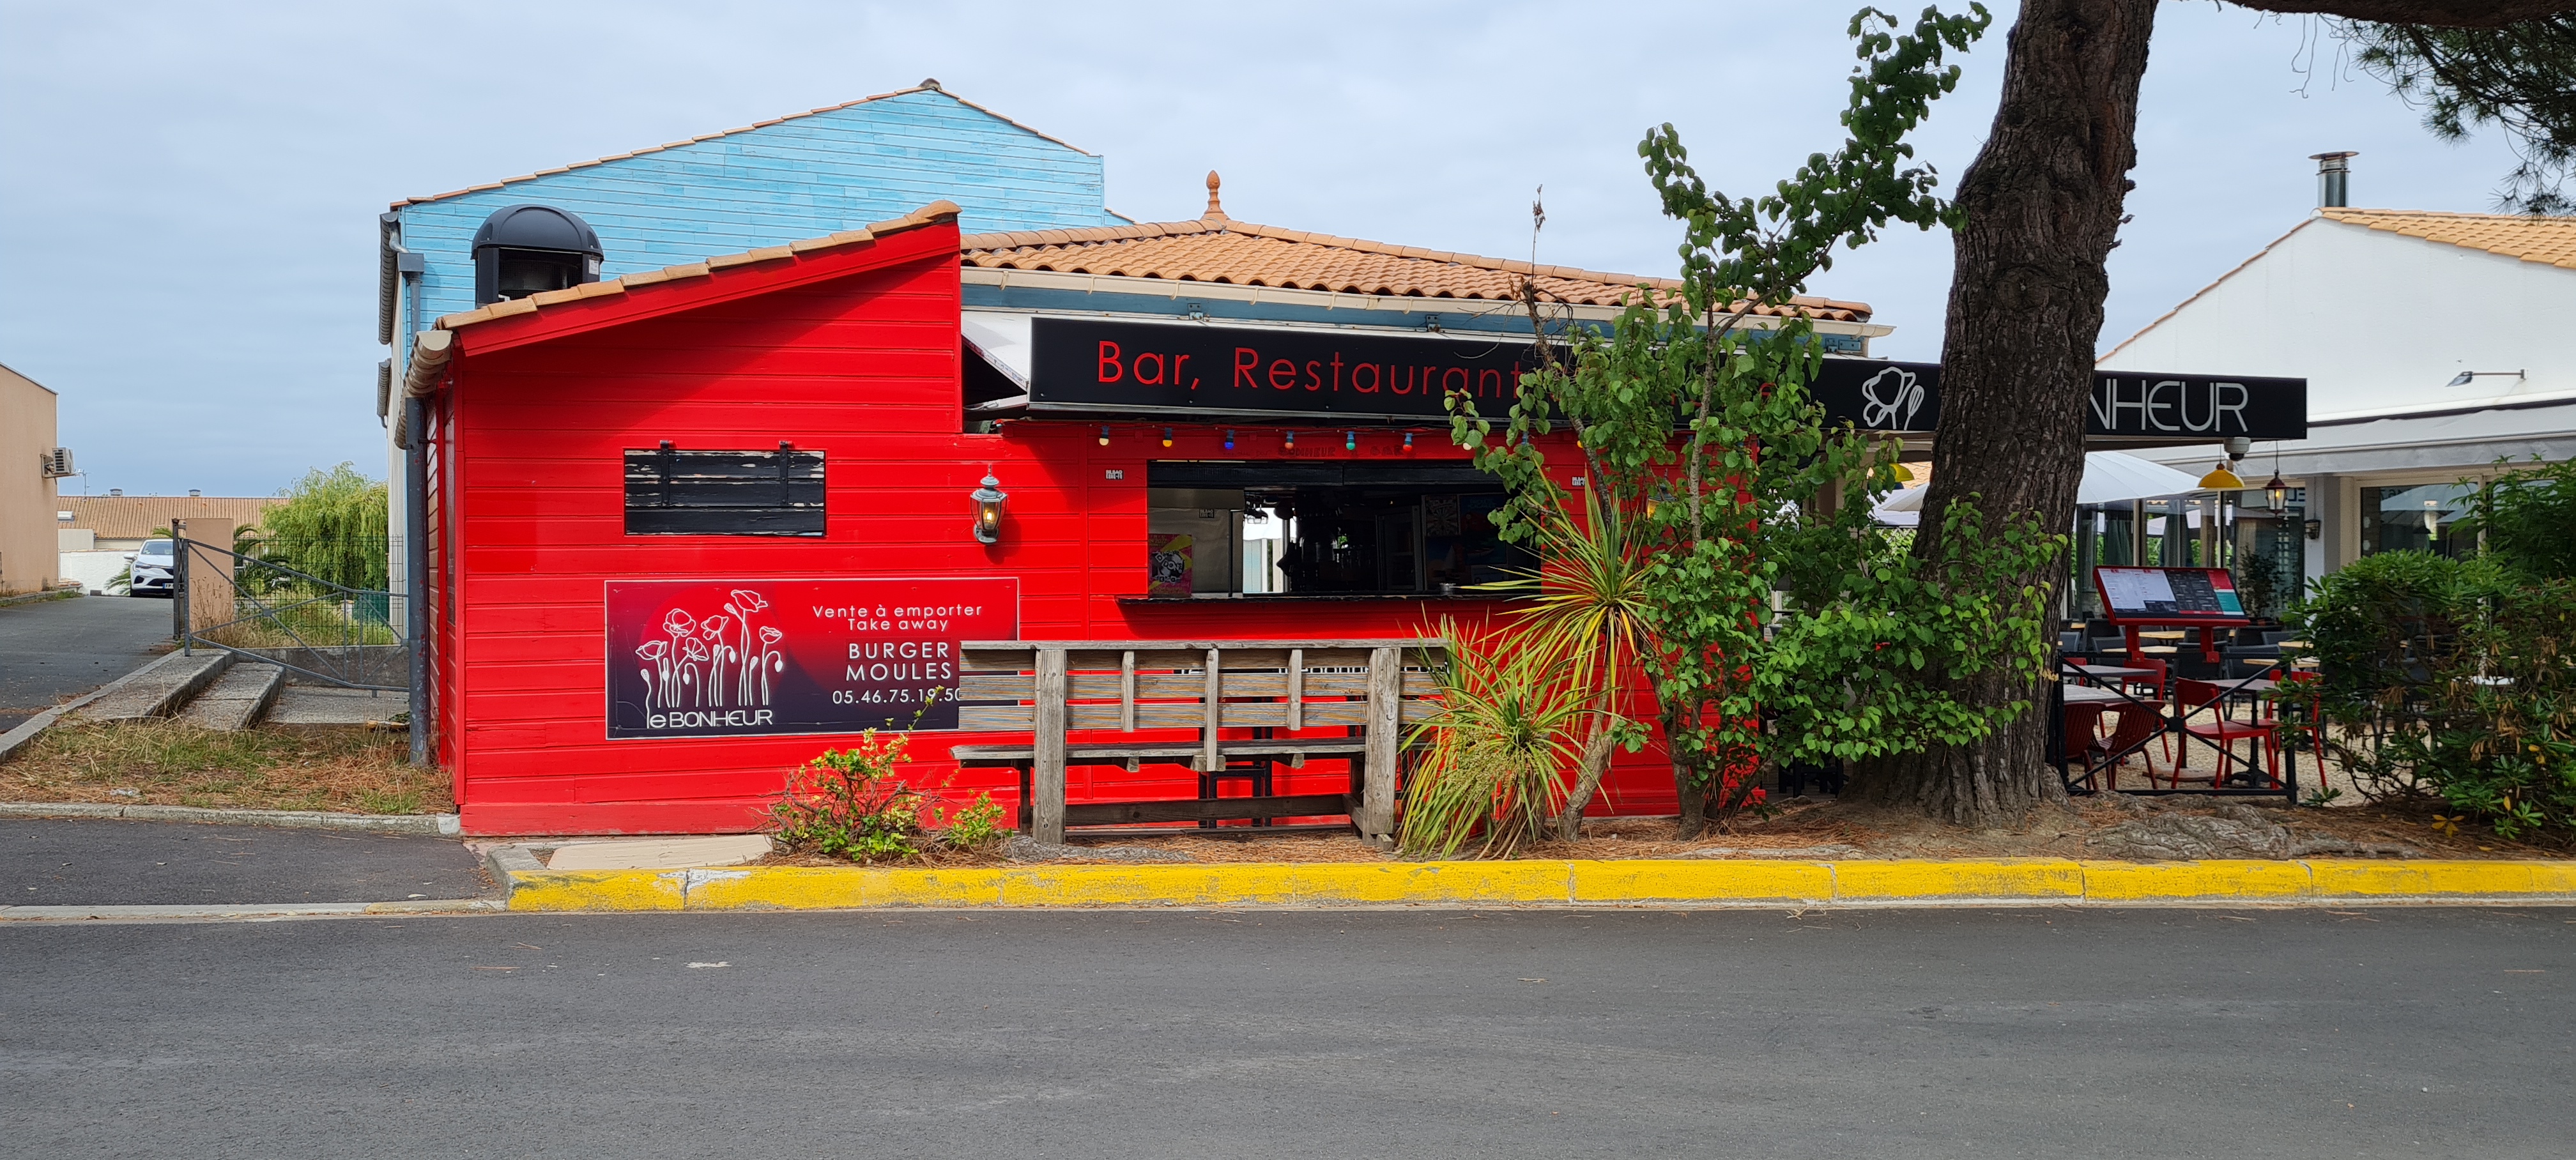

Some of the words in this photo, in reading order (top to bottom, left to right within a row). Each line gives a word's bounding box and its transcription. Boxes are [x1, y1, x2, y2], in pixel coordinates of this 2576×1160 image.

[1098, 340, 1200, 390] Bar,
[1233, 347, 1524, 398] Restaurant
[2090, 378, 2248, 432] NHEUR
[813, 605, 868, 618] Vente
[876, 603, 886, 618] à
[894, 604, 982, 620] emporter
[848, 617, 890, 630] Take
[898, 620, 949, 632] away
[848, 641, 949, 660] BURGER
[845, 662, 951, 682] MOULES
